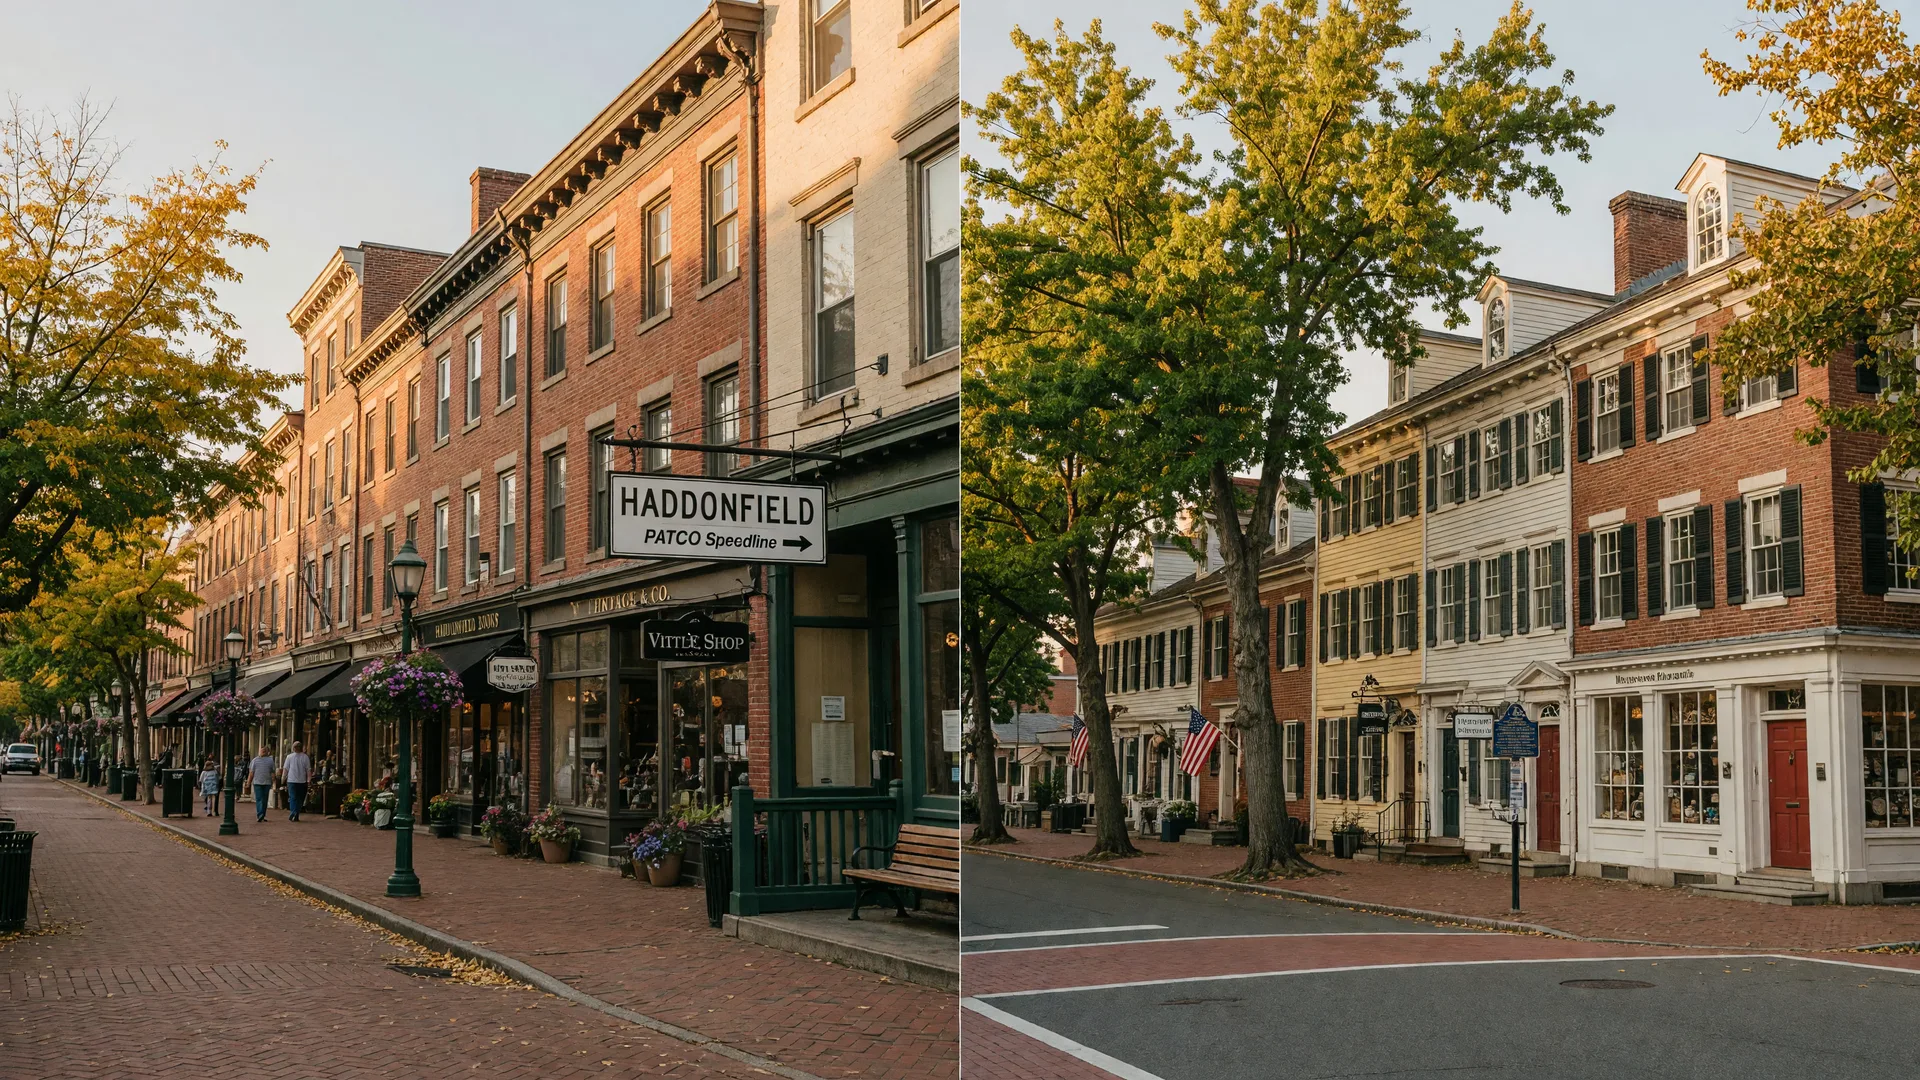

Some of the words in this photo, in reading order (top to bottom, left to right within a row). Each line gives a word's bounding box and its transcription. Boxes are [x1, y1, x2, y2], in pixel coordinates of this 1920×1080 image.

[621, 486, 814, 526] HADDONFIELD
[644, 528, 701, 546] PATCO
[705, 532, 777, 549] Speedline
[651, 585, 672, 603] CO.
[704, 633, 744, 650] SHOP
